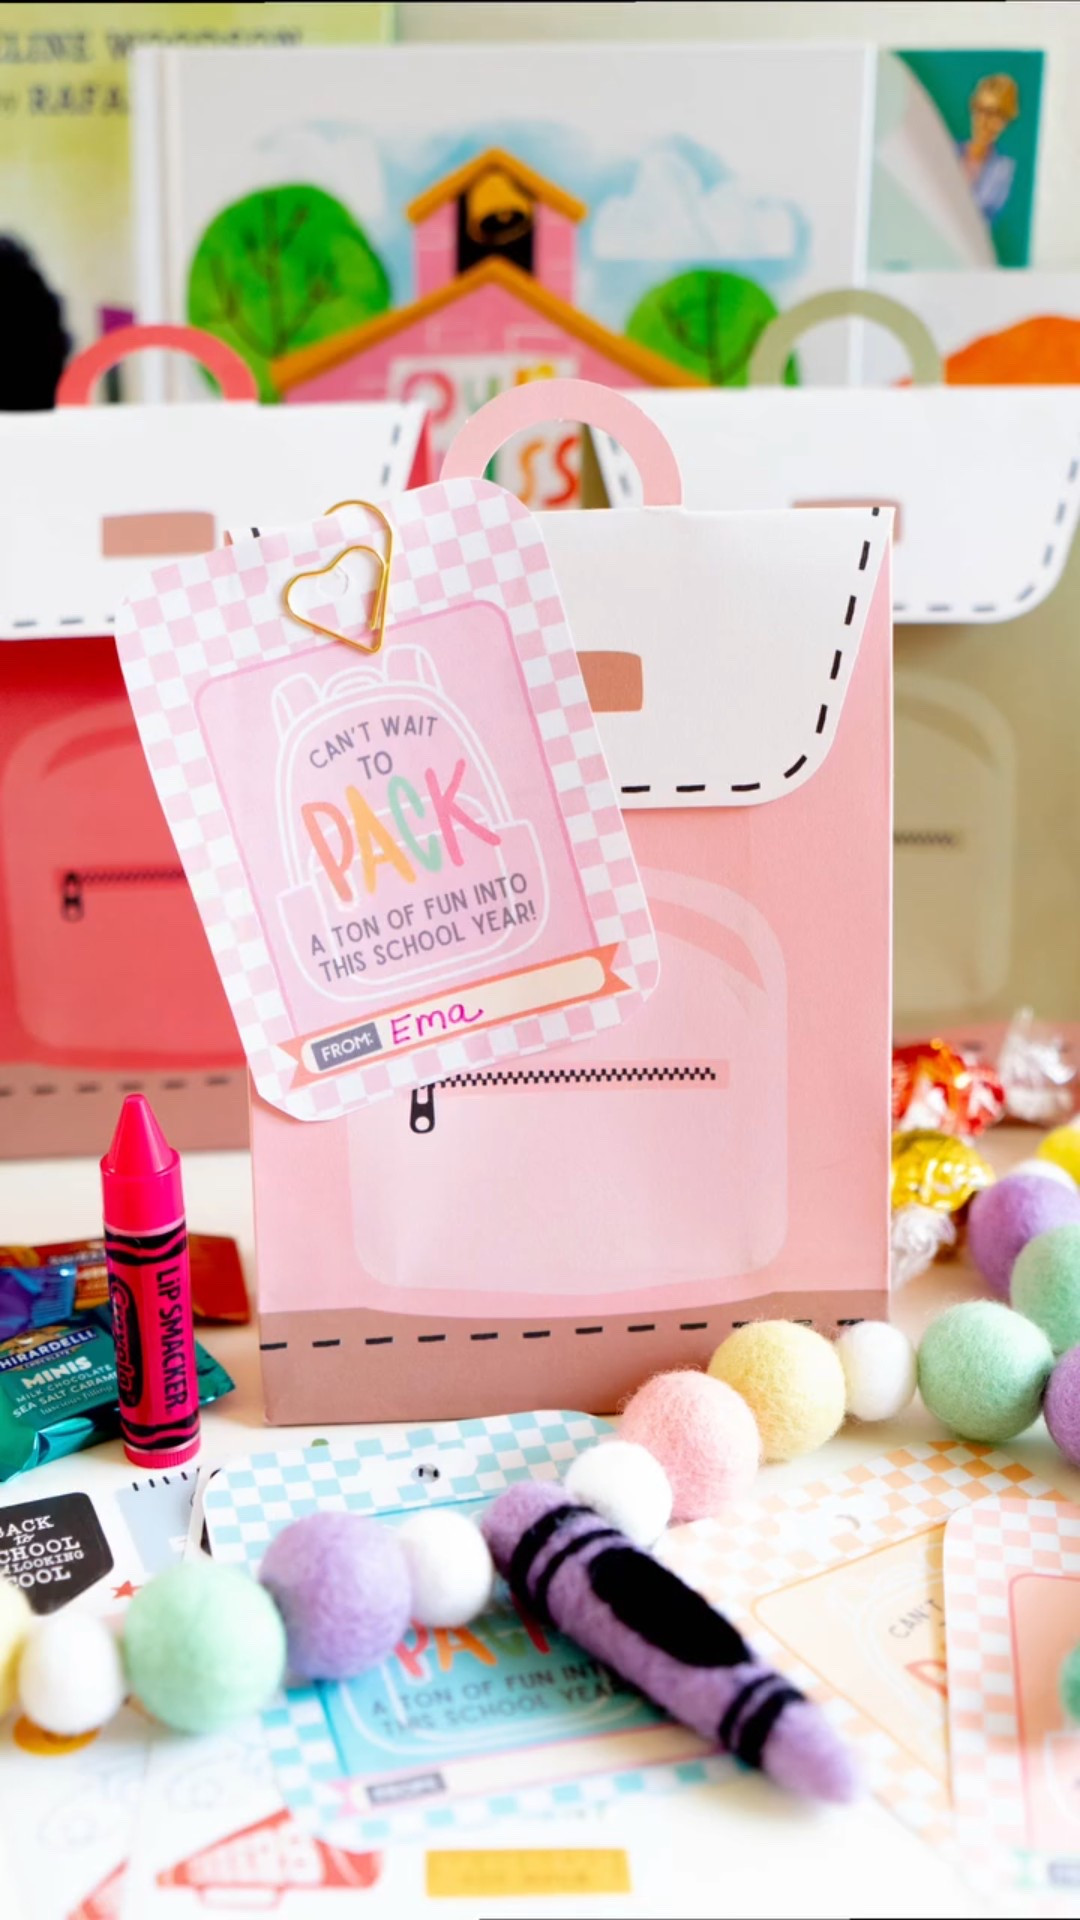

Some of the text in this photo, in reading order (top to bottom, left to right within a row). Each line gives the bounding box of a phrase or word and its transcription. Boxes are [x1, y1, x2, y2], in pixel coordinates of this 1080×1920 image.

[310, 715, 438, 769] CAN'T WAIT
[357, 750, 393, 780] TO
[301, 758, 501, 902] PACK
[311, 873, 528, 956] A TON OF FUN INTO
[319, 899, 537, 982] THIS SCHOOL YEAR!
[390, 1003, 484, 1045] Ema
[320, 1031, 375, 1062] FROM:
[16, 1364, 113, 1403] MILK CHOCOLATE
[21, 1356, 93, 1390] MINIS
[13, 1402, 38, 1418] SEA
[38, 1390, 67, 1405] SALT
[504, 1668, 556, 1692] FUN
